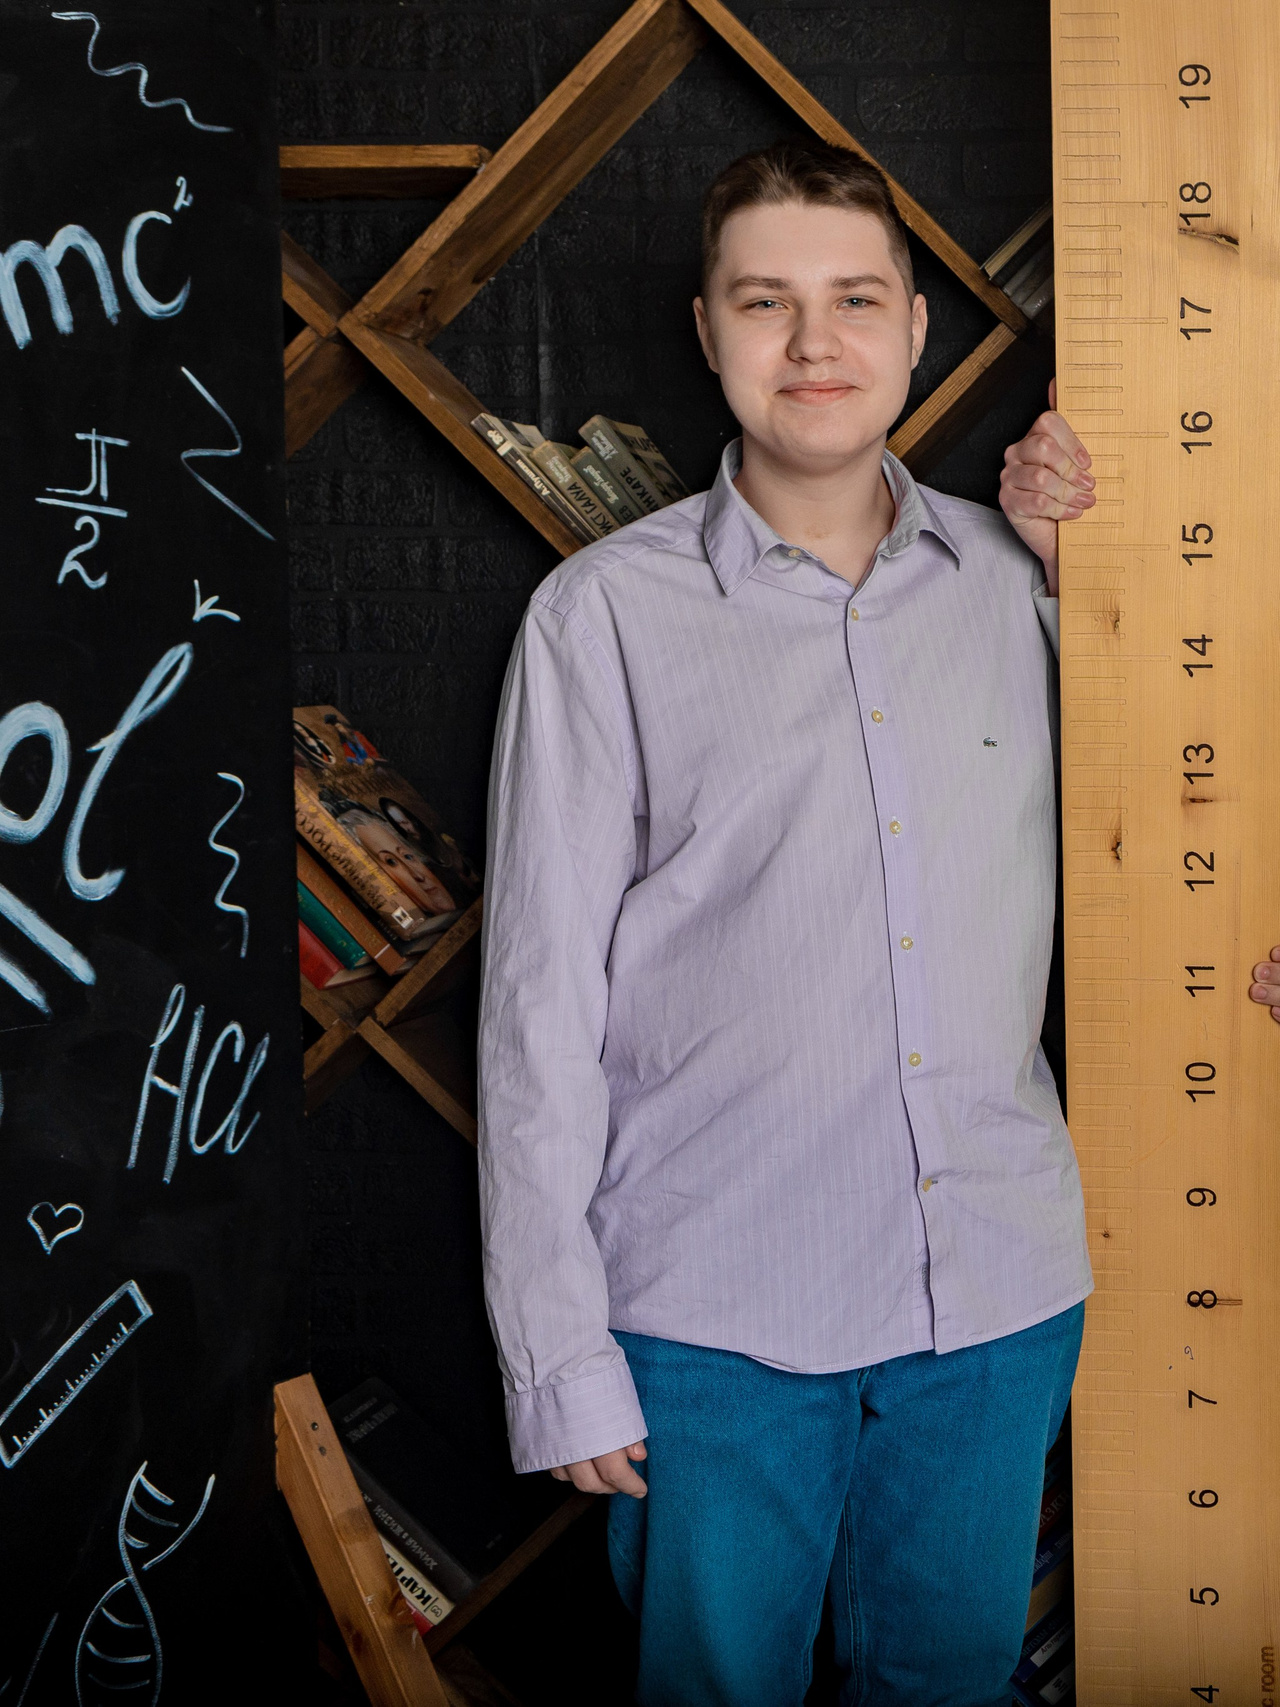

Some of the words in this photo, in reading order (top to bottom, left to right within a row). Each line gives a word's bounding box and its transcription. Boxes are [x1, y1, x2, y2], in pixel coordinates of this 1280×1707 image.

[1179, 65, 1210, 108] 19
[1180, 182, 1211, 225] 18
[1180, 298, 1211, 340] 17
[1181, 412, 1212, 454] 16
[1182, 524, 1212, 565] 15
[1183, 635, 1213, 677] 14
[1183, 744, 1214, 784] 13
[1184, 852, 1214, 891] 12
[1185, 966, 1214, 997] 11
[1186, 1063, 1215, 1102] 10
[1187, 1188, 1217, 1207] 9
[1187, 1290, 1217, 1309] 8
[1188, 1390, 1217, 1408] 7
[1189, 1490, 1218, 1508] 6
[405, 1537, 437, 1571] ХИМИЯ
[1190, 1587, 1219, 1606] 5
[1261, 1646, 1275, 1694] room
[1191, 1685, 1219, 1703] 4
